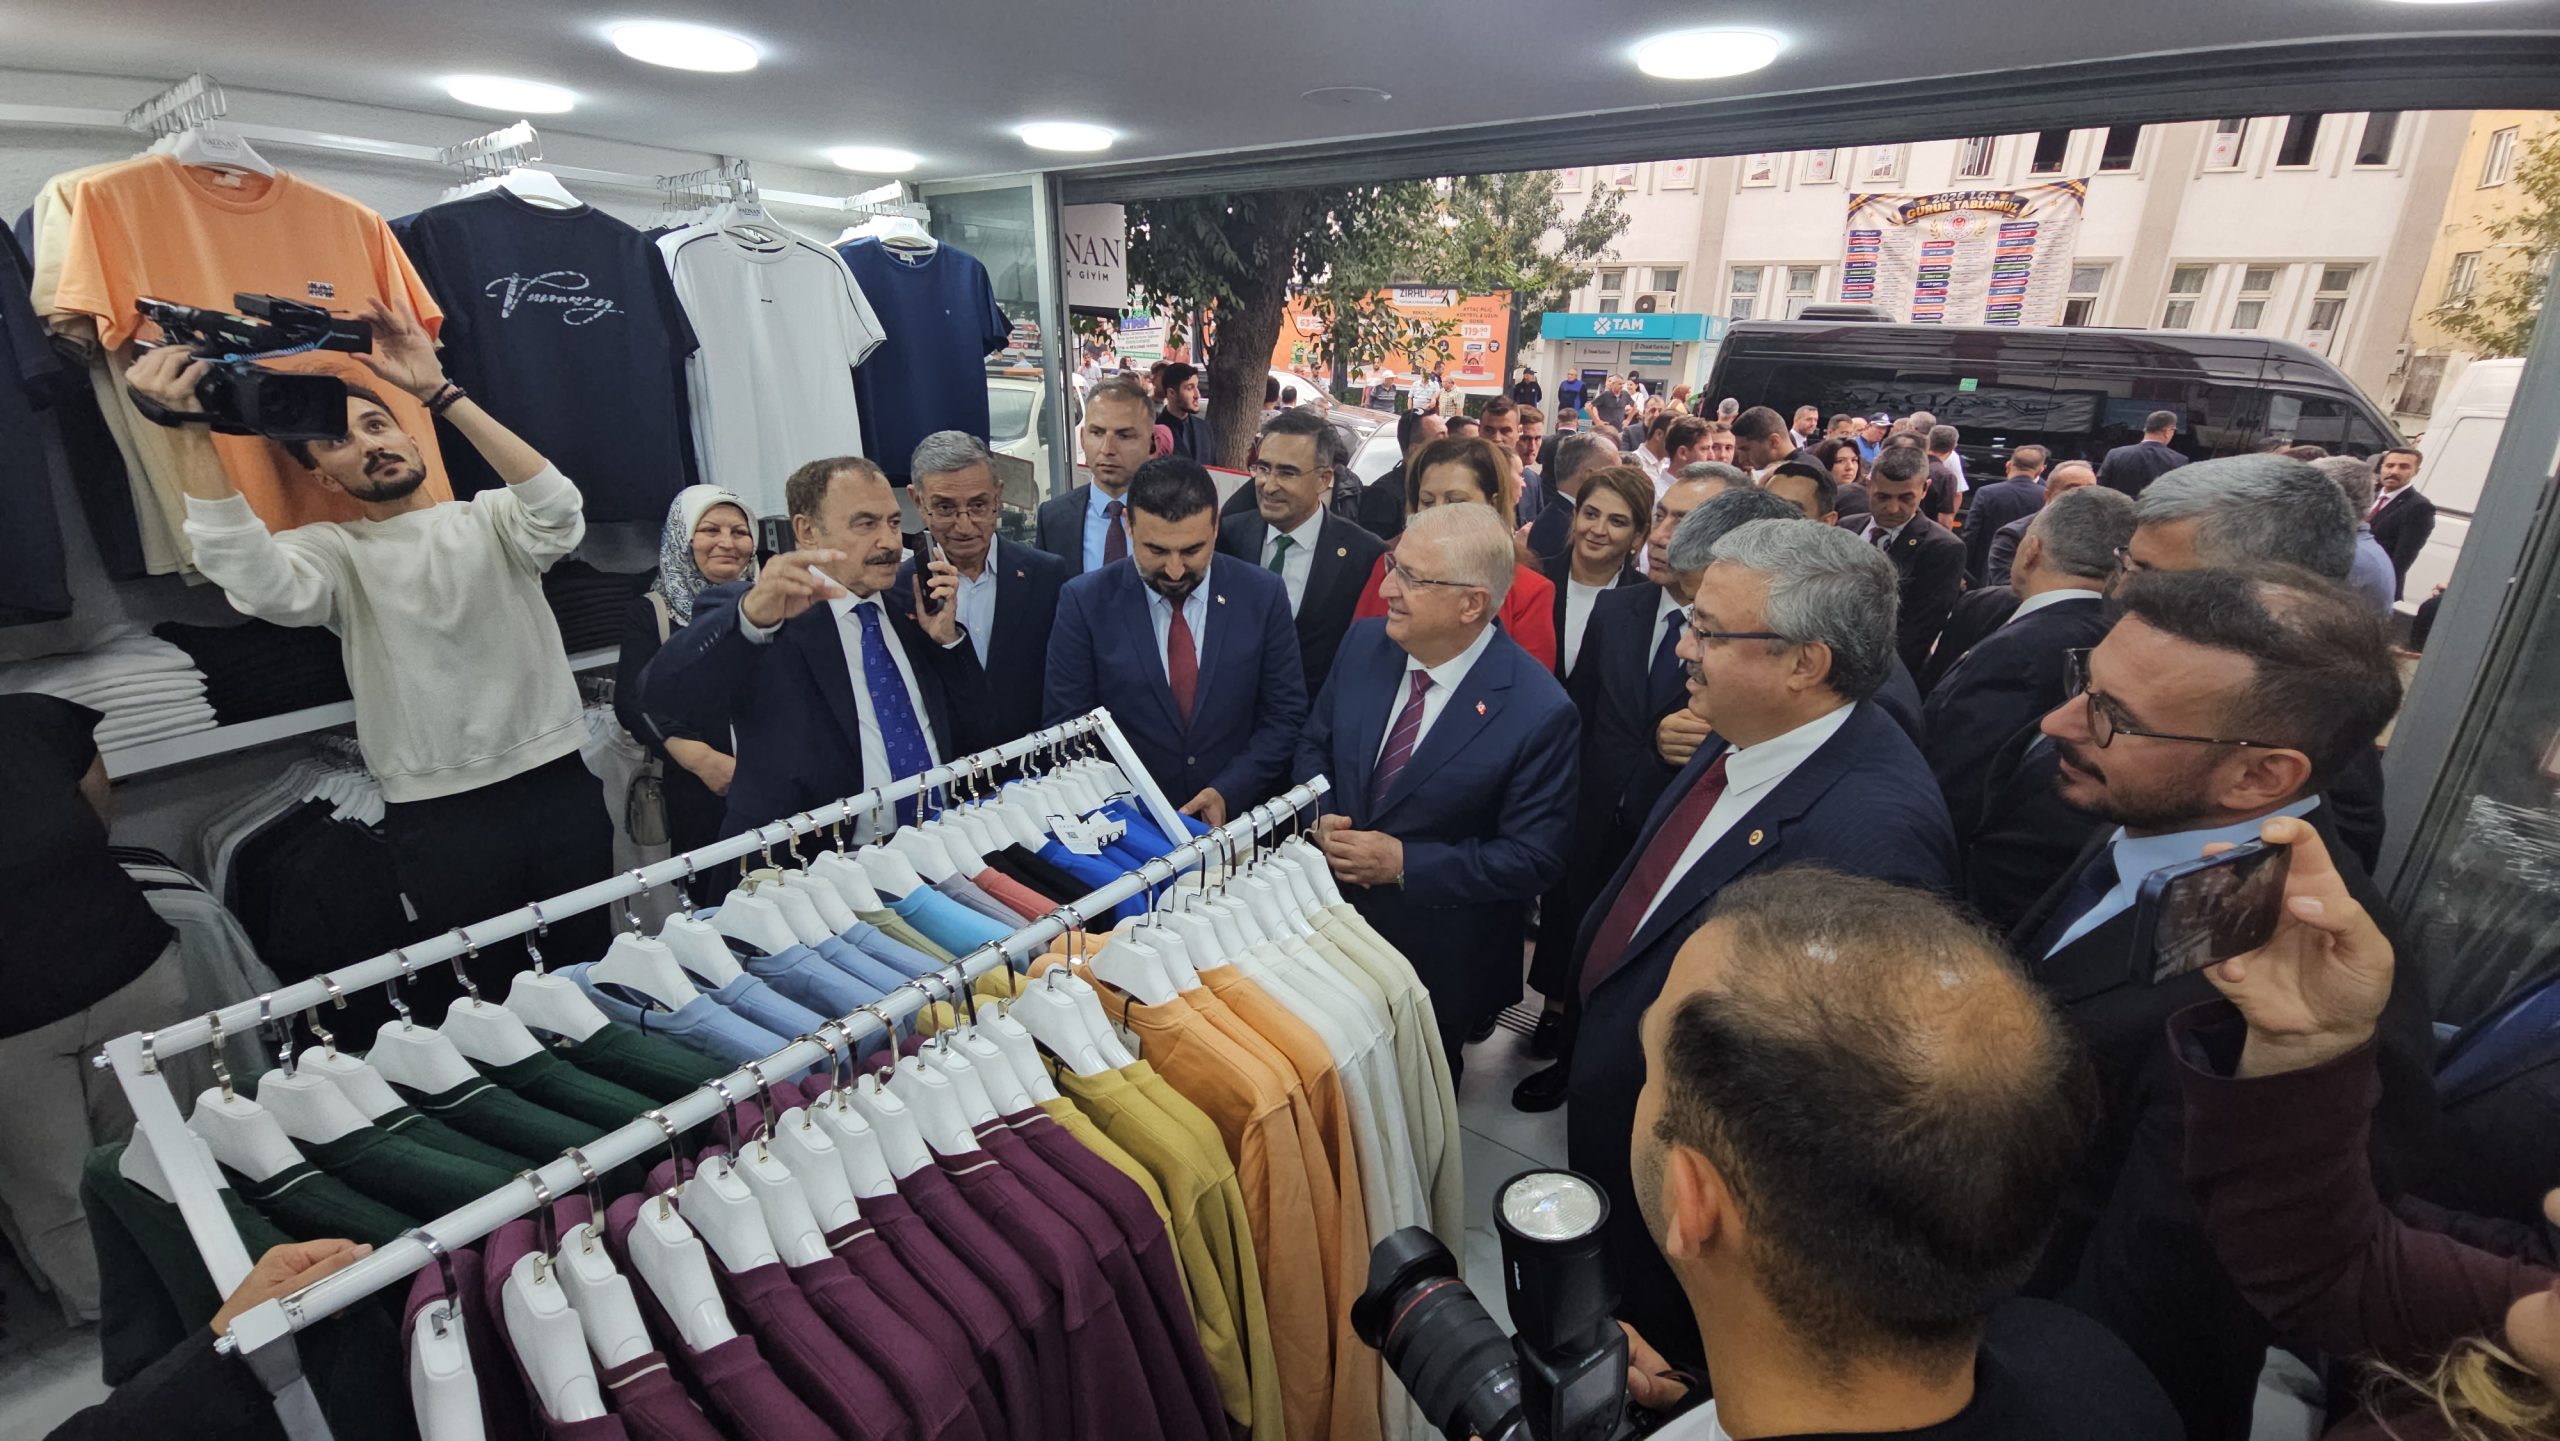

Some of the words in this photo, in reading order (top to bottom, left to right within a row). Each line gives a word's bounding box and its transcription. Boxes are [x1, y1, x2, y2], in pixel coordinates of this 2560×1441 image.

[1969, 190, 1996, 201] LGS
[1906, 202, 1951, 219] GURUR
[1954, 200, 2020, 213] TABLOMUZ
[1079, 270, 1109, 281] GİYİM
[1613, 318, 1644, 330] TAM
